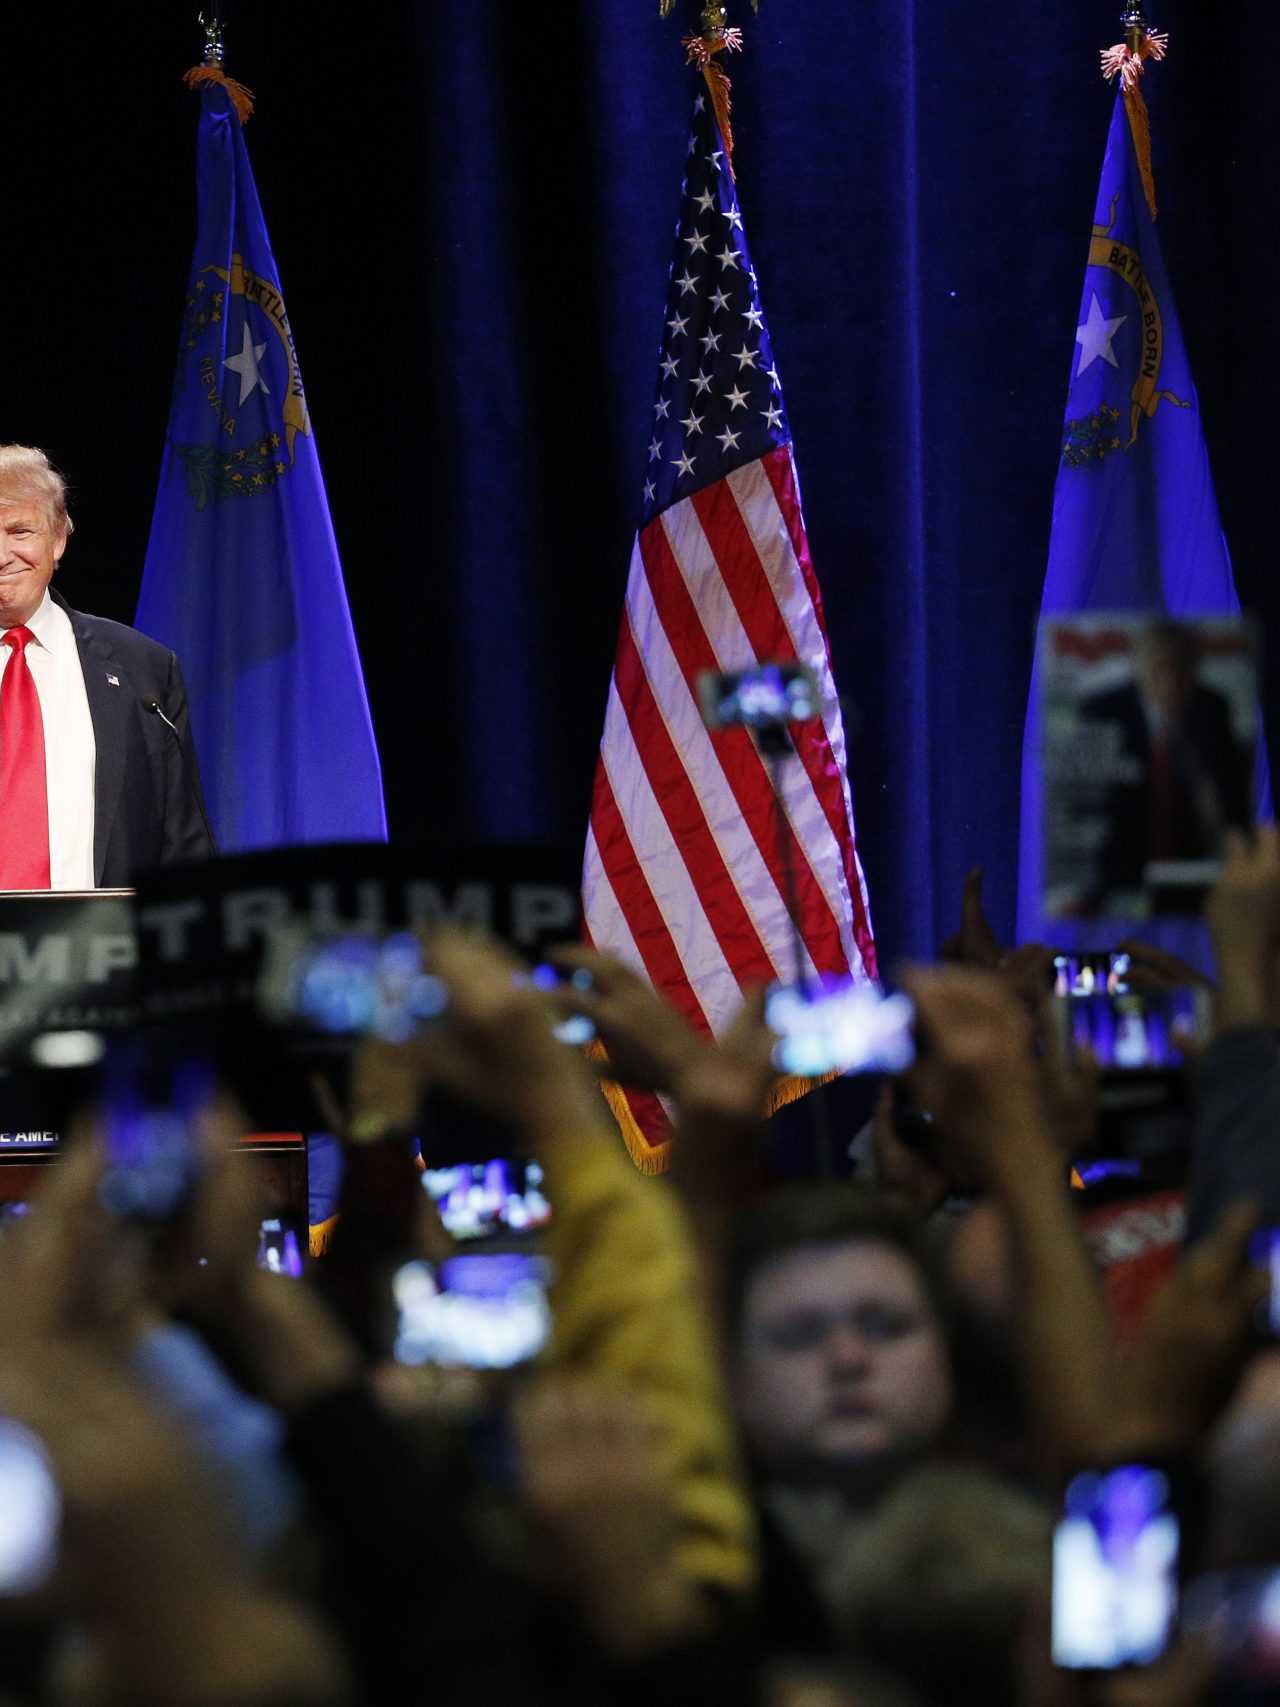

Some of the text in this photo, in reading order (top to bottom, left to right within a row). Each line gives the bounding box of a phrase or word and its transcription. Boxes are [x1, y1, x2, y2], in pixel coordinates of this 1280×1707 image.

[1109, 246, 1158, 378] BATTLE BORN
[200, 356, 236, 437] NEVADA
[140, 879, 578, 963] TRUMP
